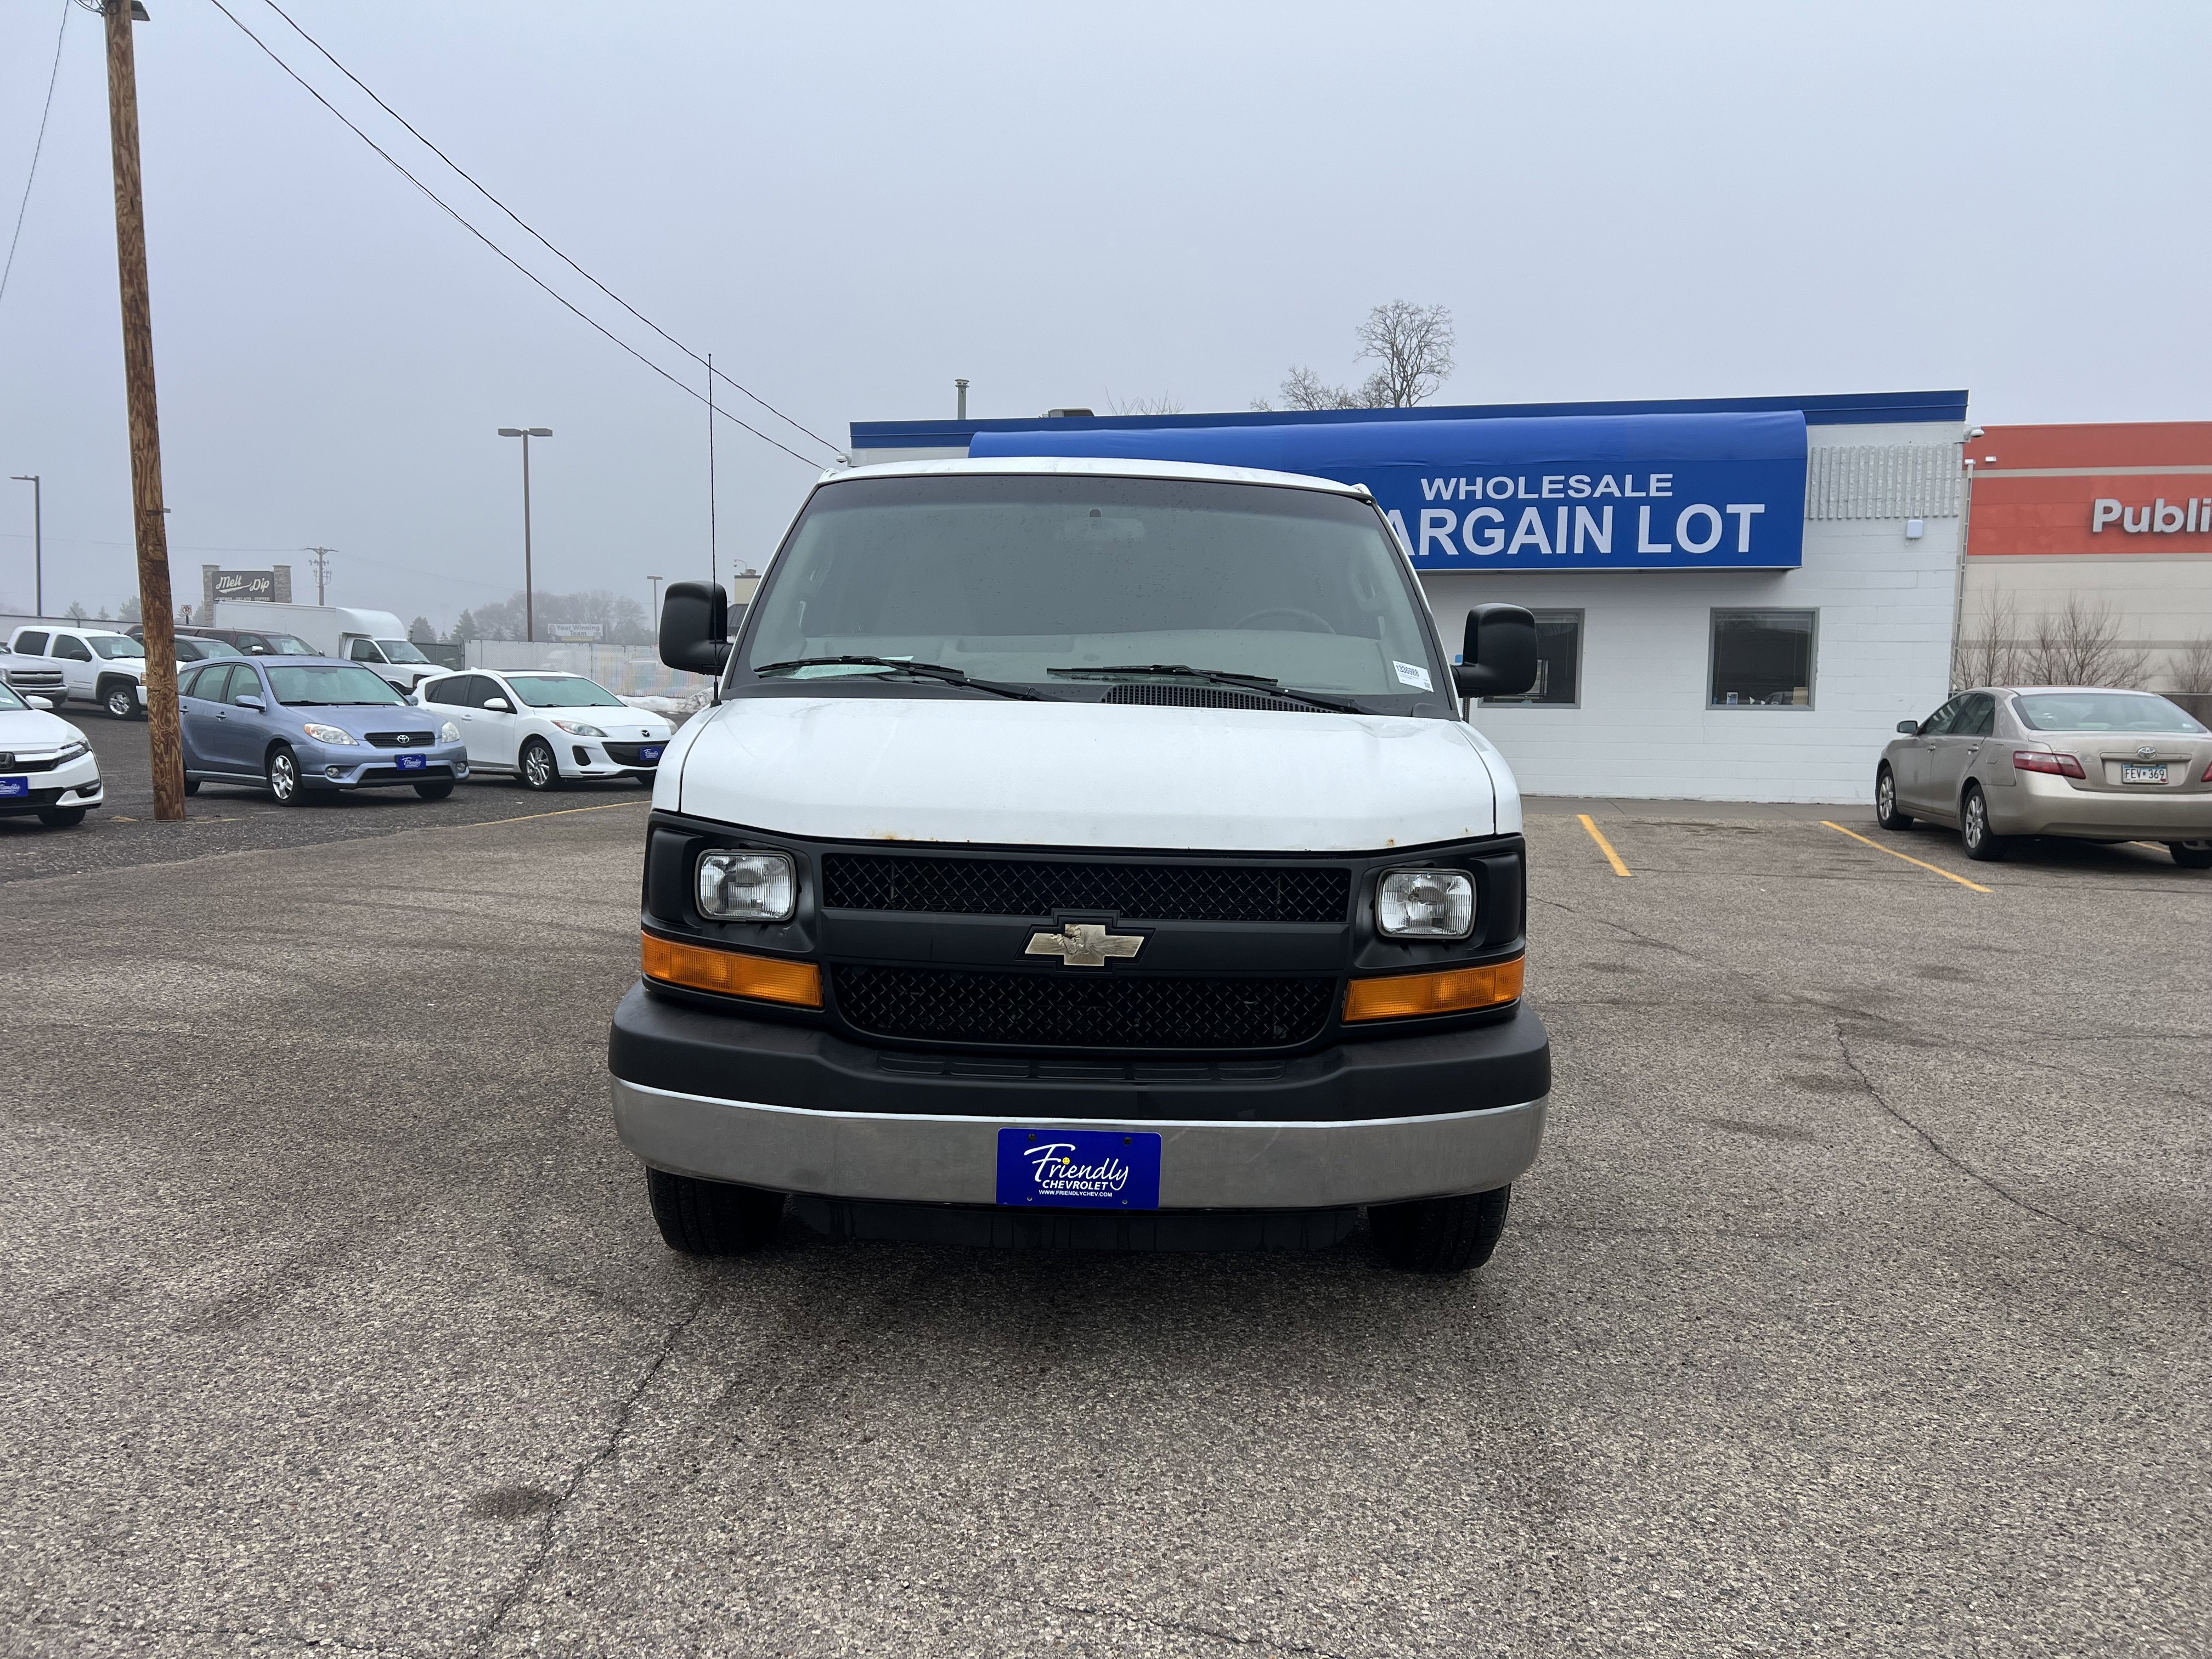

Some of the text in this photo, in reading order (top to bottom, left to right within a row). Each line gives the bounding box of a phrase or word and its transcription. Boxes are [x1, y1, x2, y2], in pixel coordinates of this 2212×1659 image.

[1420, 473, 1674, 501] WHOLESALE
[2092, 498, 2211, 533] Publi
[1386, 503, 1765, 556] ARGAIN LOT
[216, 574, 270, 593] Melt Dip
[2125, 769, 2164, 779] FEV 369
[1024, 1143, 1129, 1191] Friendly
[1039, 1189, 1113, 1198] WWW.FRIENDLYCHEV.COM
[1042, 1180, 1109, 1190] CHEVROLET
